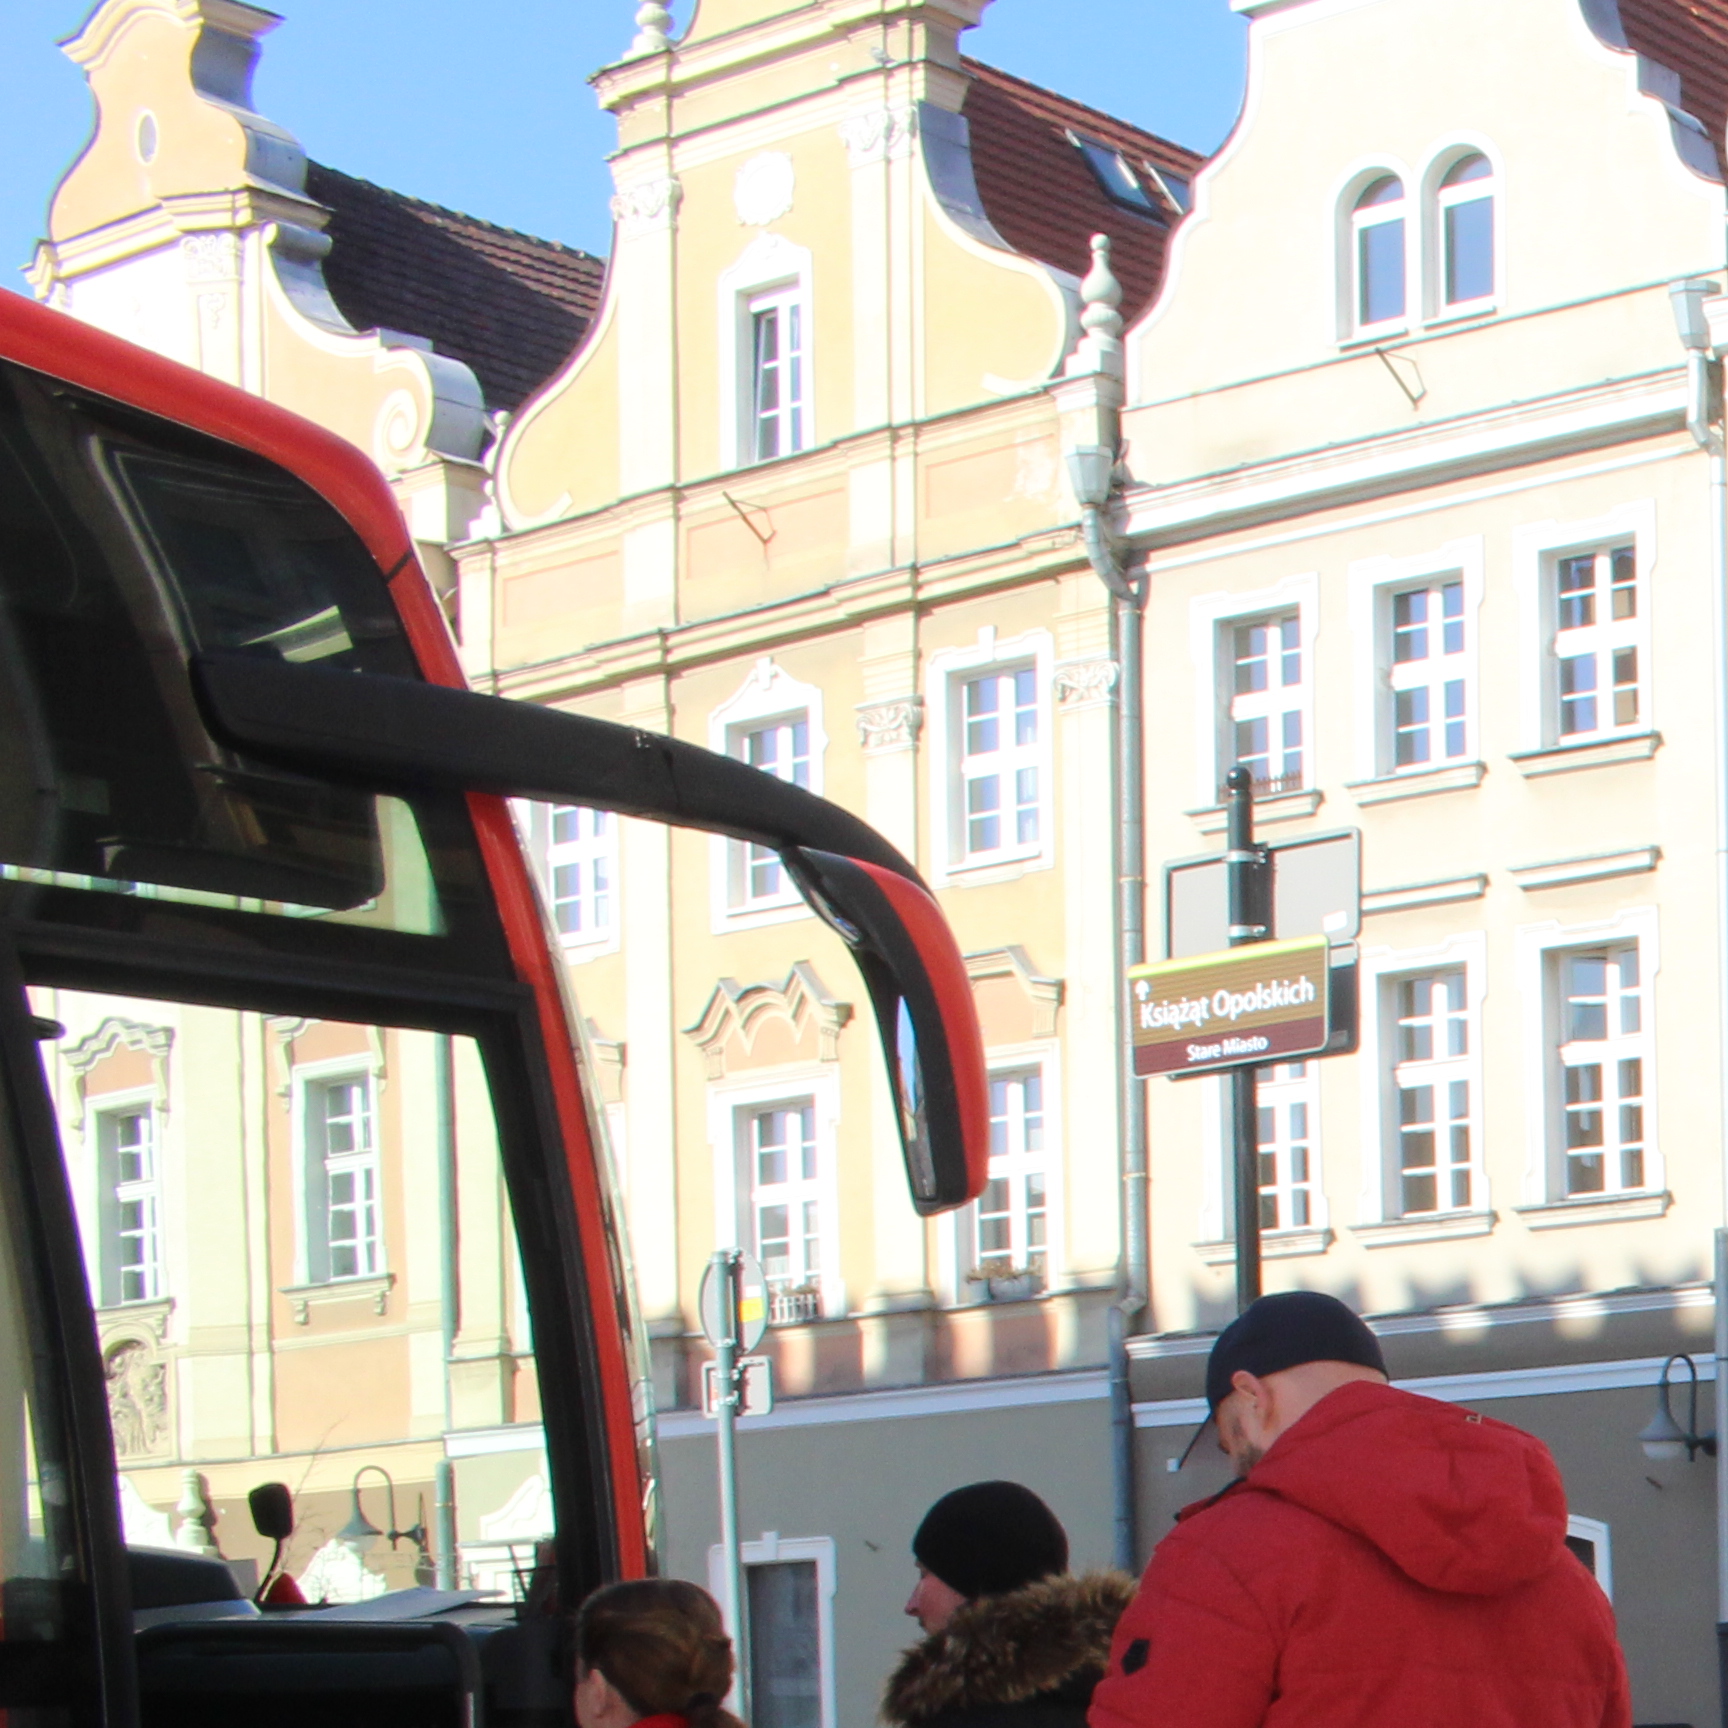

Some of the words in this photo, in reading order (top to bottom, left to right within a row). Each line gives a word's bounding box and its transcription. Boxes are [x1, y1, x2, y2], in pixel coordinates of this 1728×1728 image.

[1140, 996, 1210, 1030] Książąt
[1212, 975, 1316, 1020] Opolskich
[1186, 1043, 1222, 1062] Stare
[1222, 1035, 1270, 1056] Miasto
